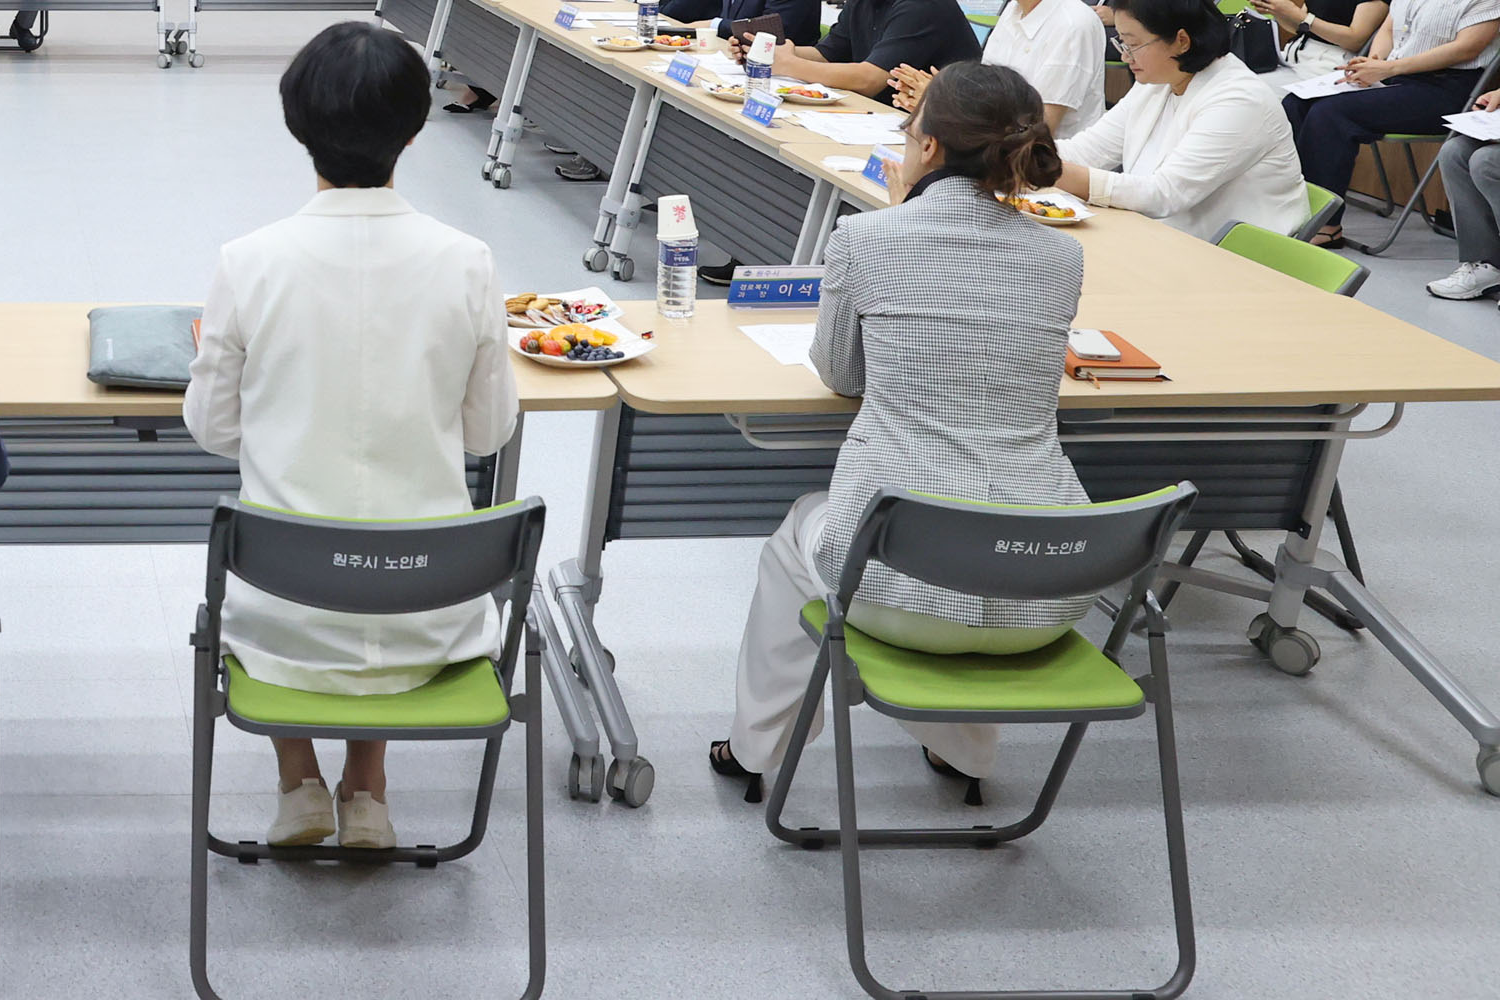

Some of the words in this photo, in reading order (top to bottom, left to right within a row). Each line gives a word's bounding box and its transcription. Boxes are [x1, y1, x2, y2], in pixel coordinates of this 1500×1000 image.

[778, 283, 823, 297] 이석
[994, 539, 1041, 555] 원주시
[1045, 539, 1087, 555] 노인회
[332, 552, 378, 569] 원주시
[384, 554, 429, 570] 노인회
